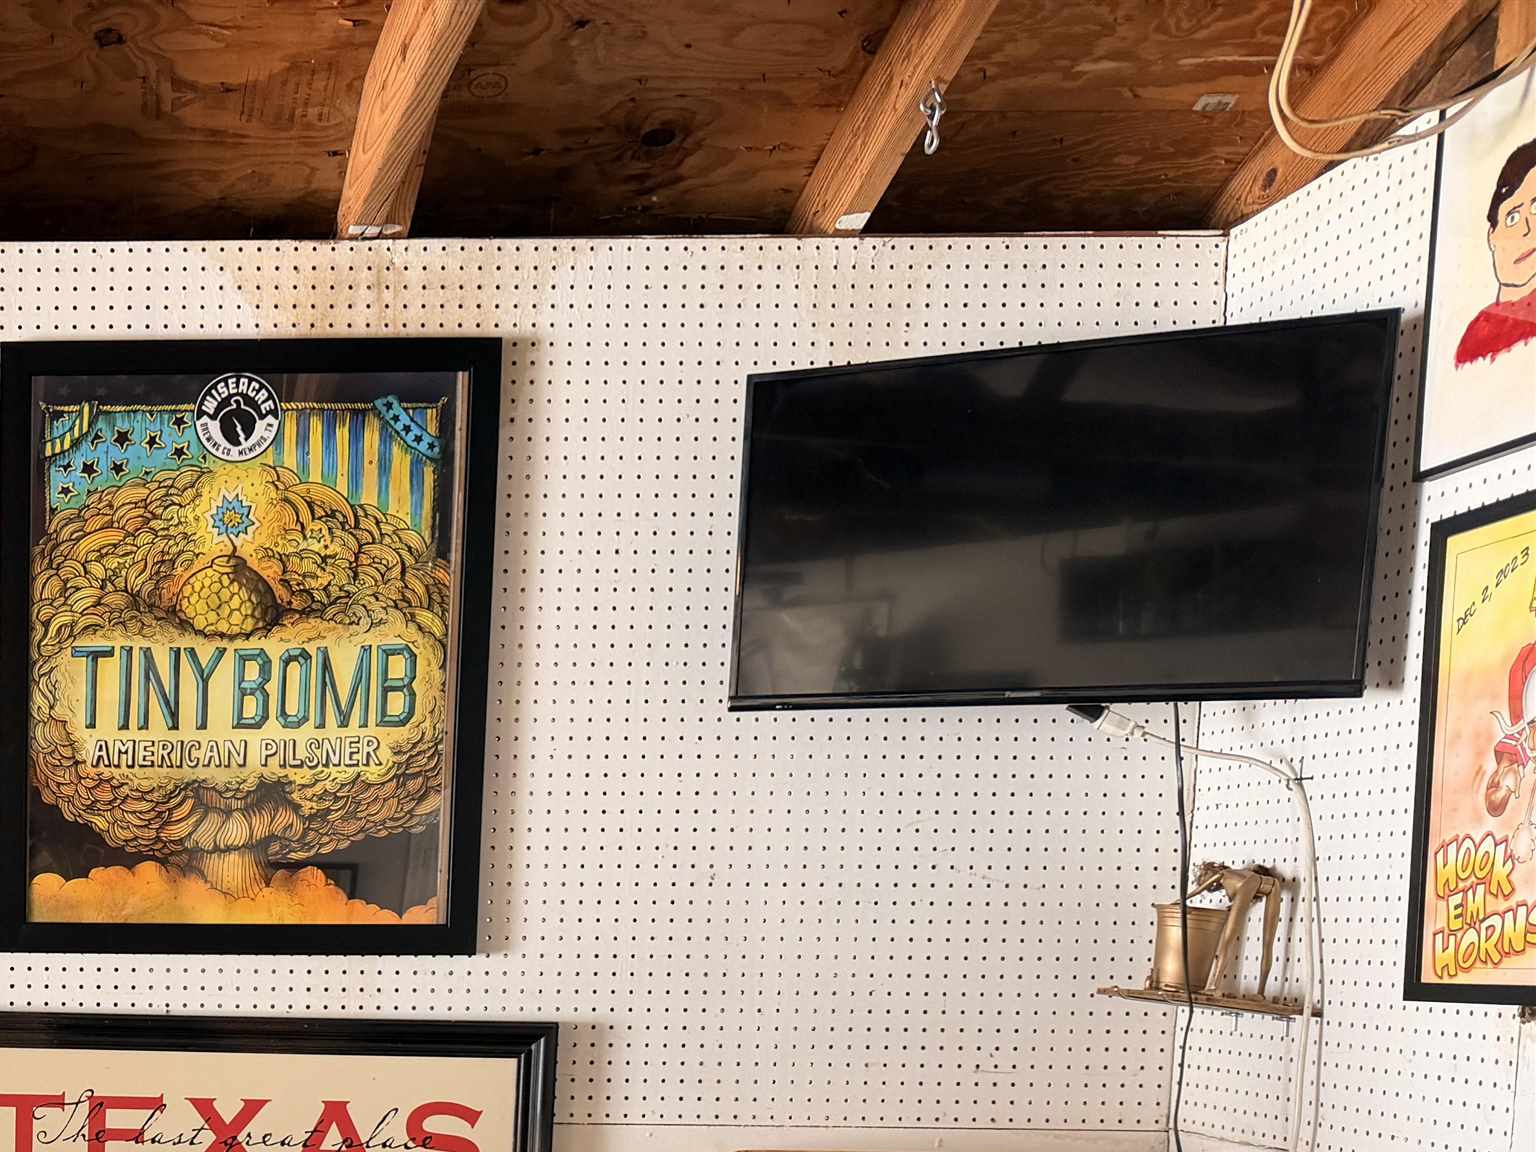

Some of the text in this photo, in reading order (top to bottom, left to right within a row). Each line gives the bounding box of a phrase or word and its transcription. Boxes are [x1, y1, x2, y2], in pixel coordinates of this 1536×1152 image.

[201, 377, 275, 415] WISEACRE
[199, 422, 222, 452] BREWING
[1456, 546, 1530, 635] DEC 2, 2023
[71, 643, 419, 732] TINY BOMB
[90, 735, 383, 770] AMERICAN PILSNER
[1434, 831, 1515, 898] HOOK
[1448, 882, 1487, 932] EM
[32, 1088, 108, 1145] The
[126, 1103, 204, 1146] last
